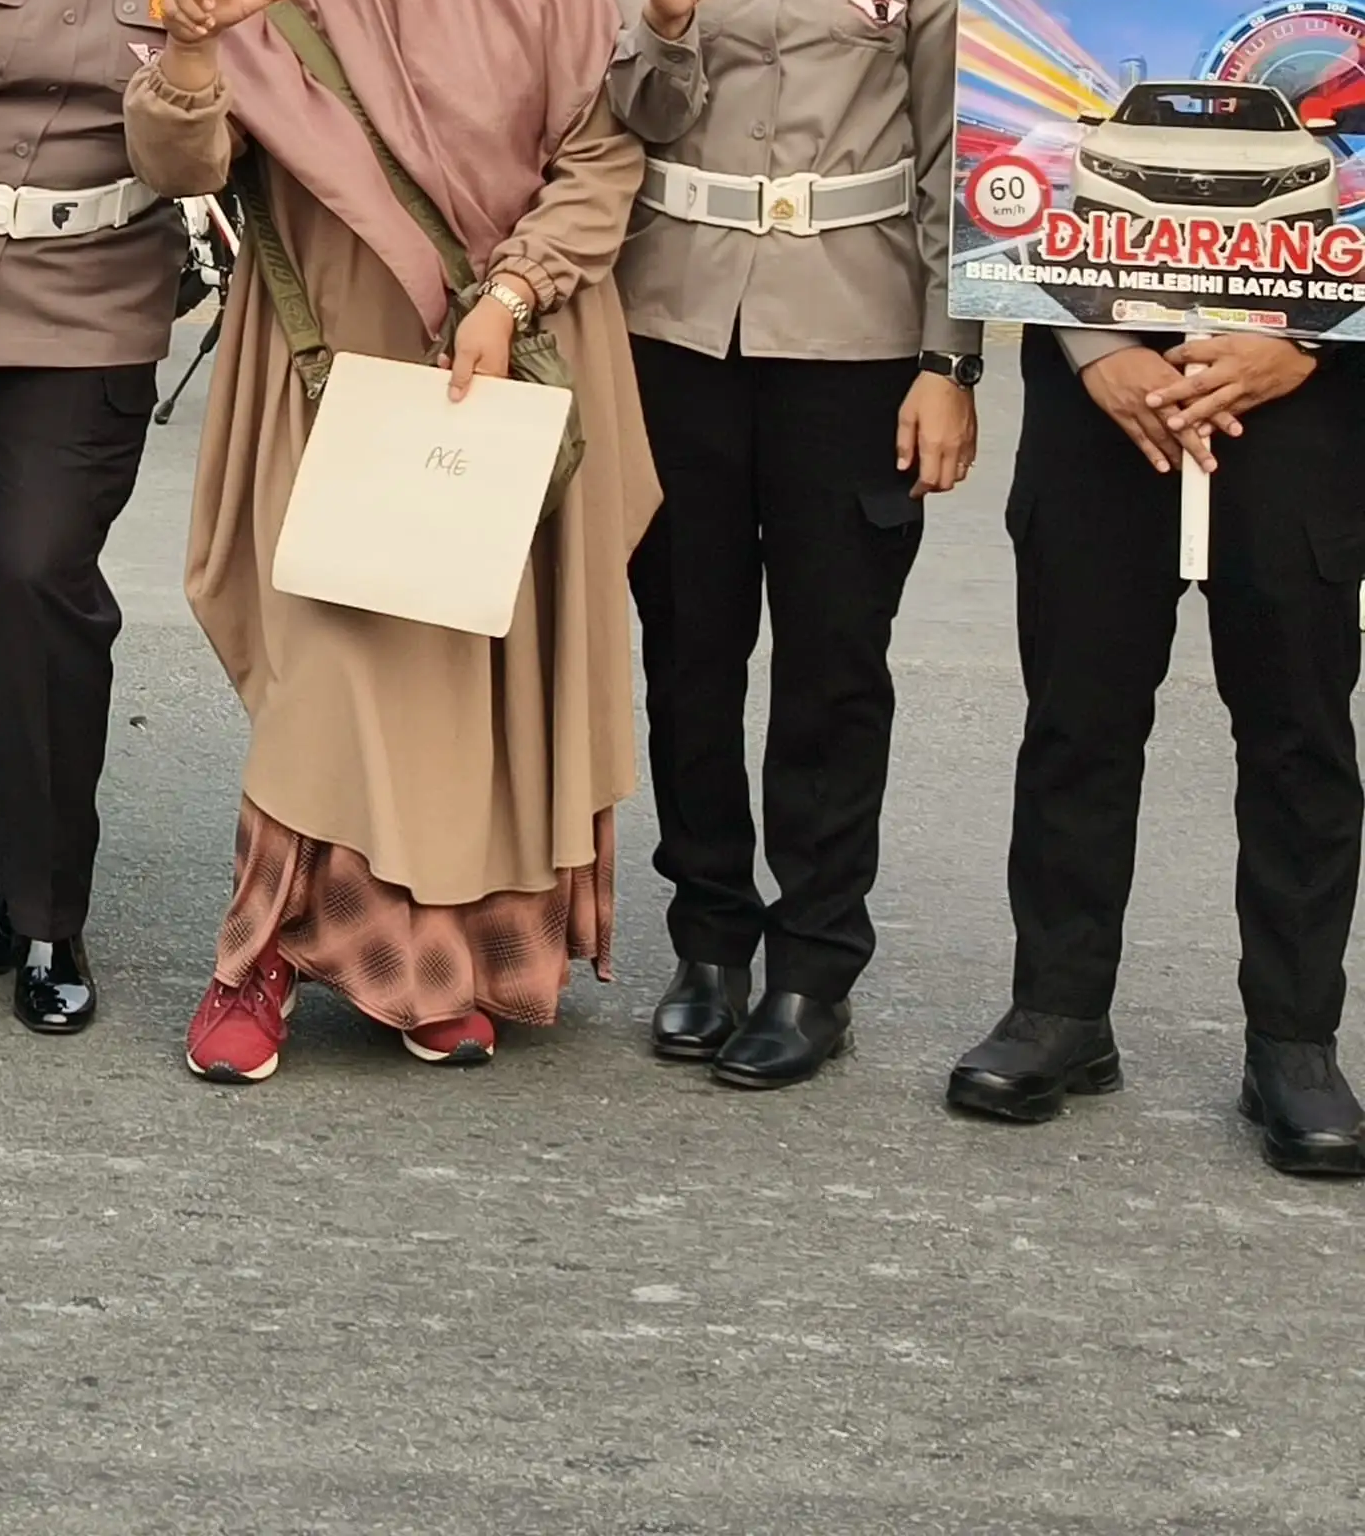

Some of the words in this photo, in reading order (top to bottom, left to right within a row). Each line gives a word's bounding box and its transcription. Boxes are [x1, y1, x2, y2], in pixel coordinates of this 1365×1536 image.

[988, 175, 1026, 201] 60
[992, 203, 1027, 217] km/h
[1044, 210, 1365, 275] DILARANG
[965, 263, 1115, 289] BERKENDARA
[1119, 270, 1224, 296] MELEBIHI
[1229, 277, 1303, 300] BATAS
[1307, 281, 1365, 303] KECE
